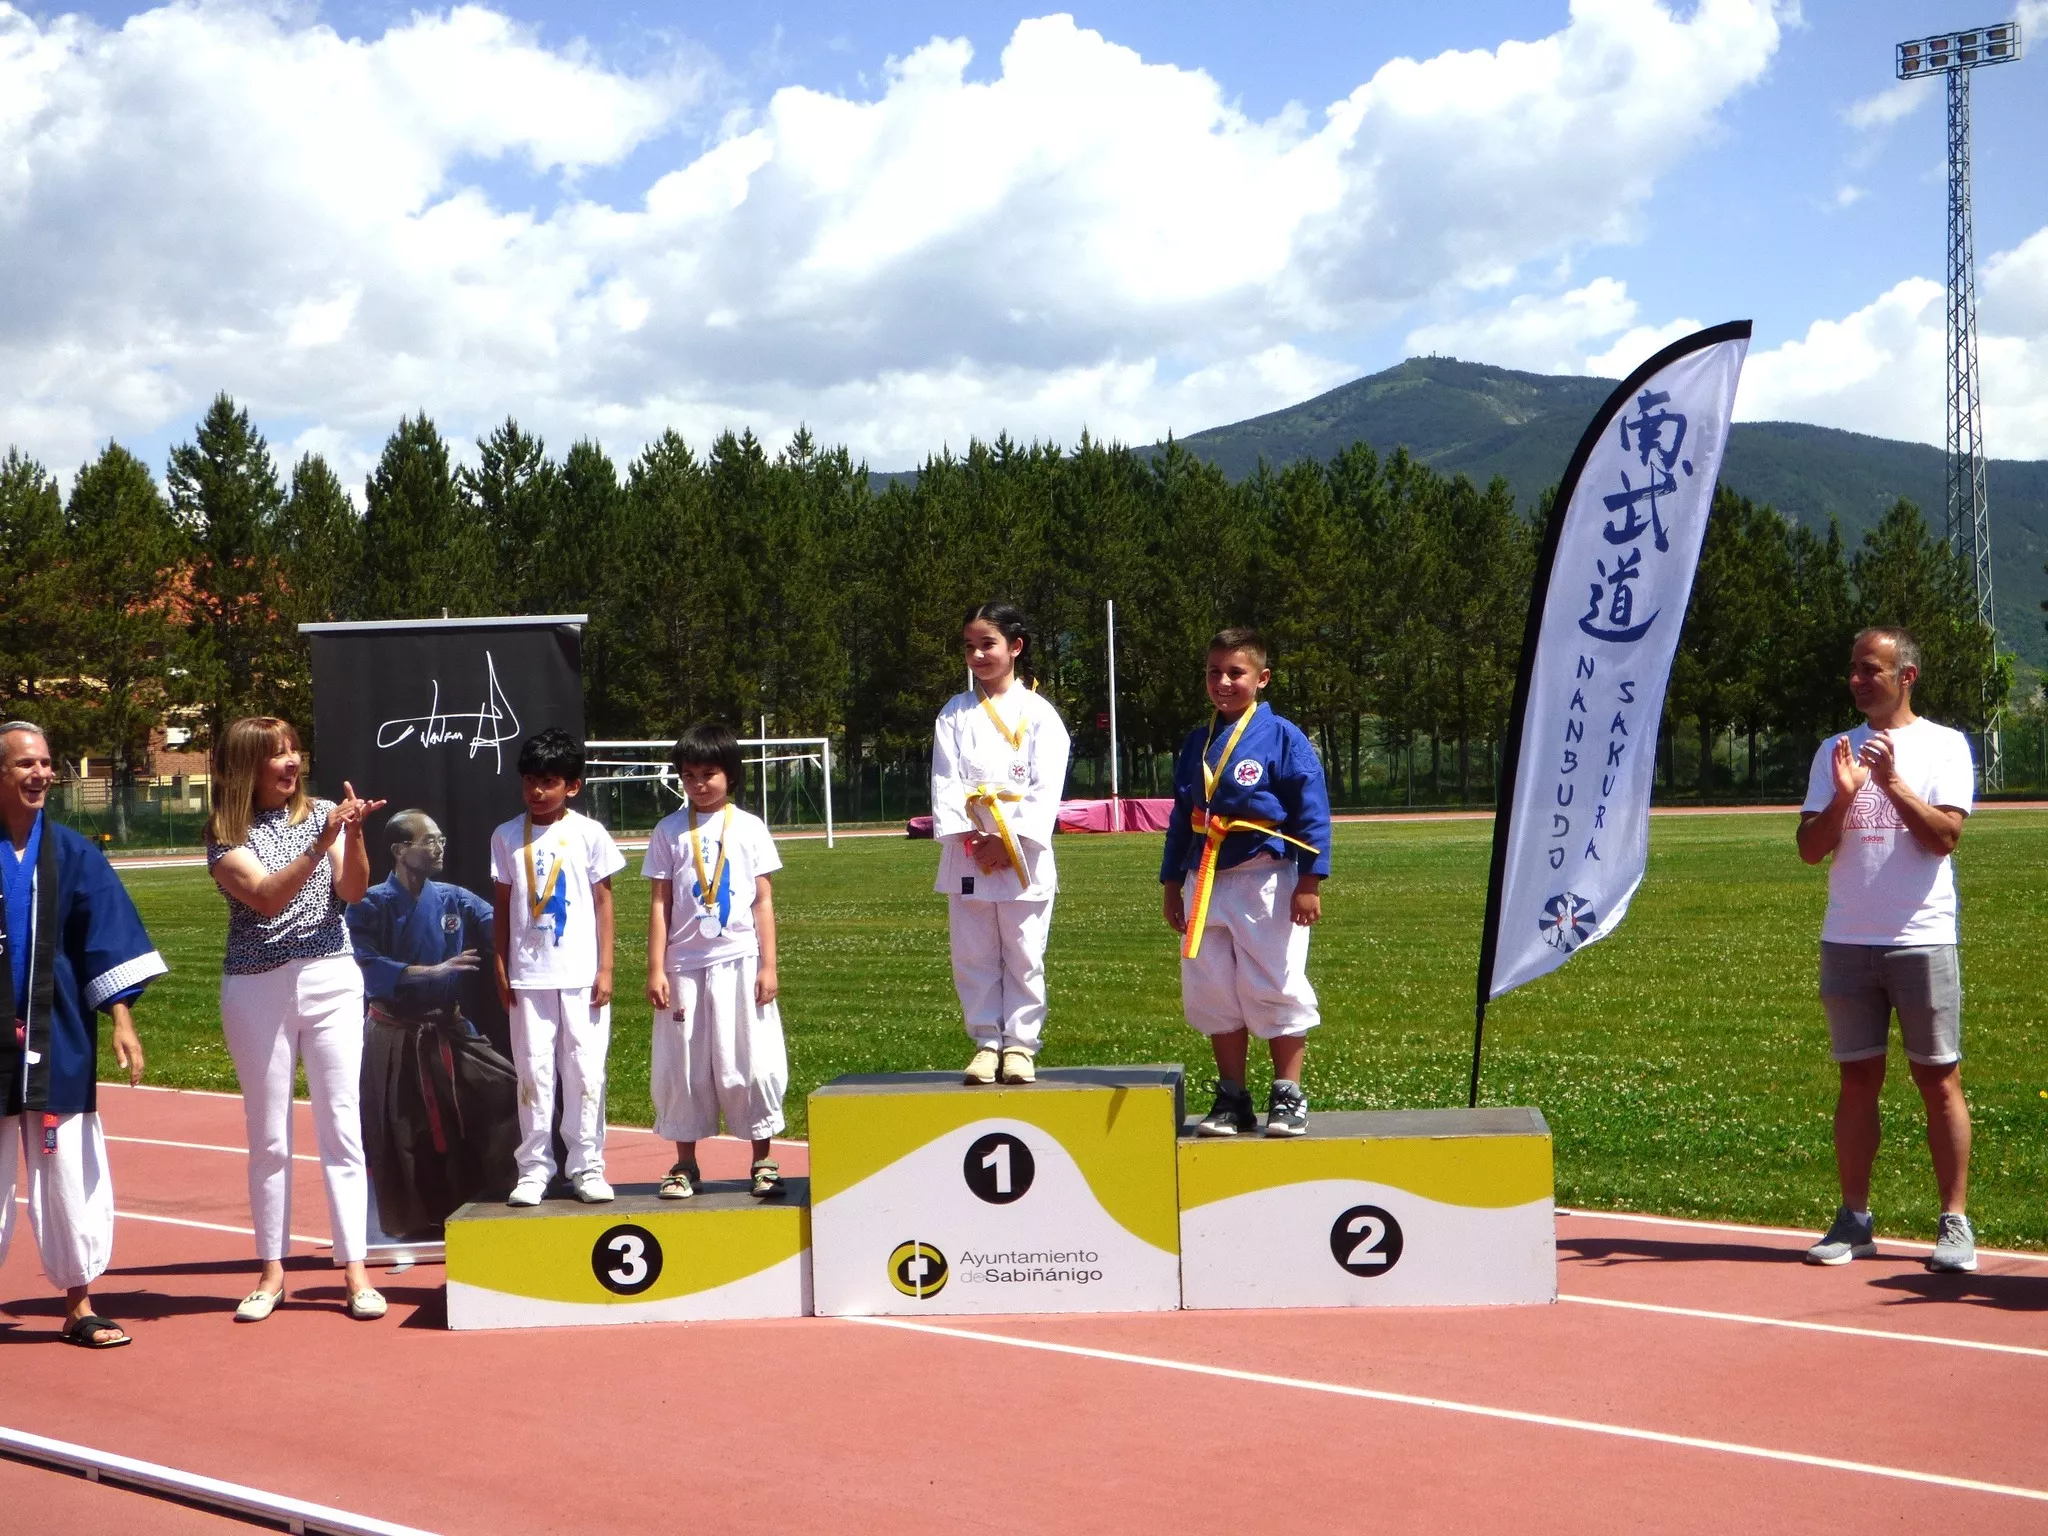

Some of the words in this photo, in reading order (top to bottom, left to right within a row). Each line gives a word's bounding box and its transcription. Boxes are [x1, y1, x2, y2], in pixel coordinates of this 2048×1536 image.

[1548, 655, 1594, 870] NANBUDO
[1585, 681, 1635, 861] SAKURA
[983, 1145, 1011, 1192] 1
[608, 1235, 647, 1284] 3
[960, 1249, 1099, 1268] Ayuntamiento
[1347, 1217, 1386, 1264] 2
